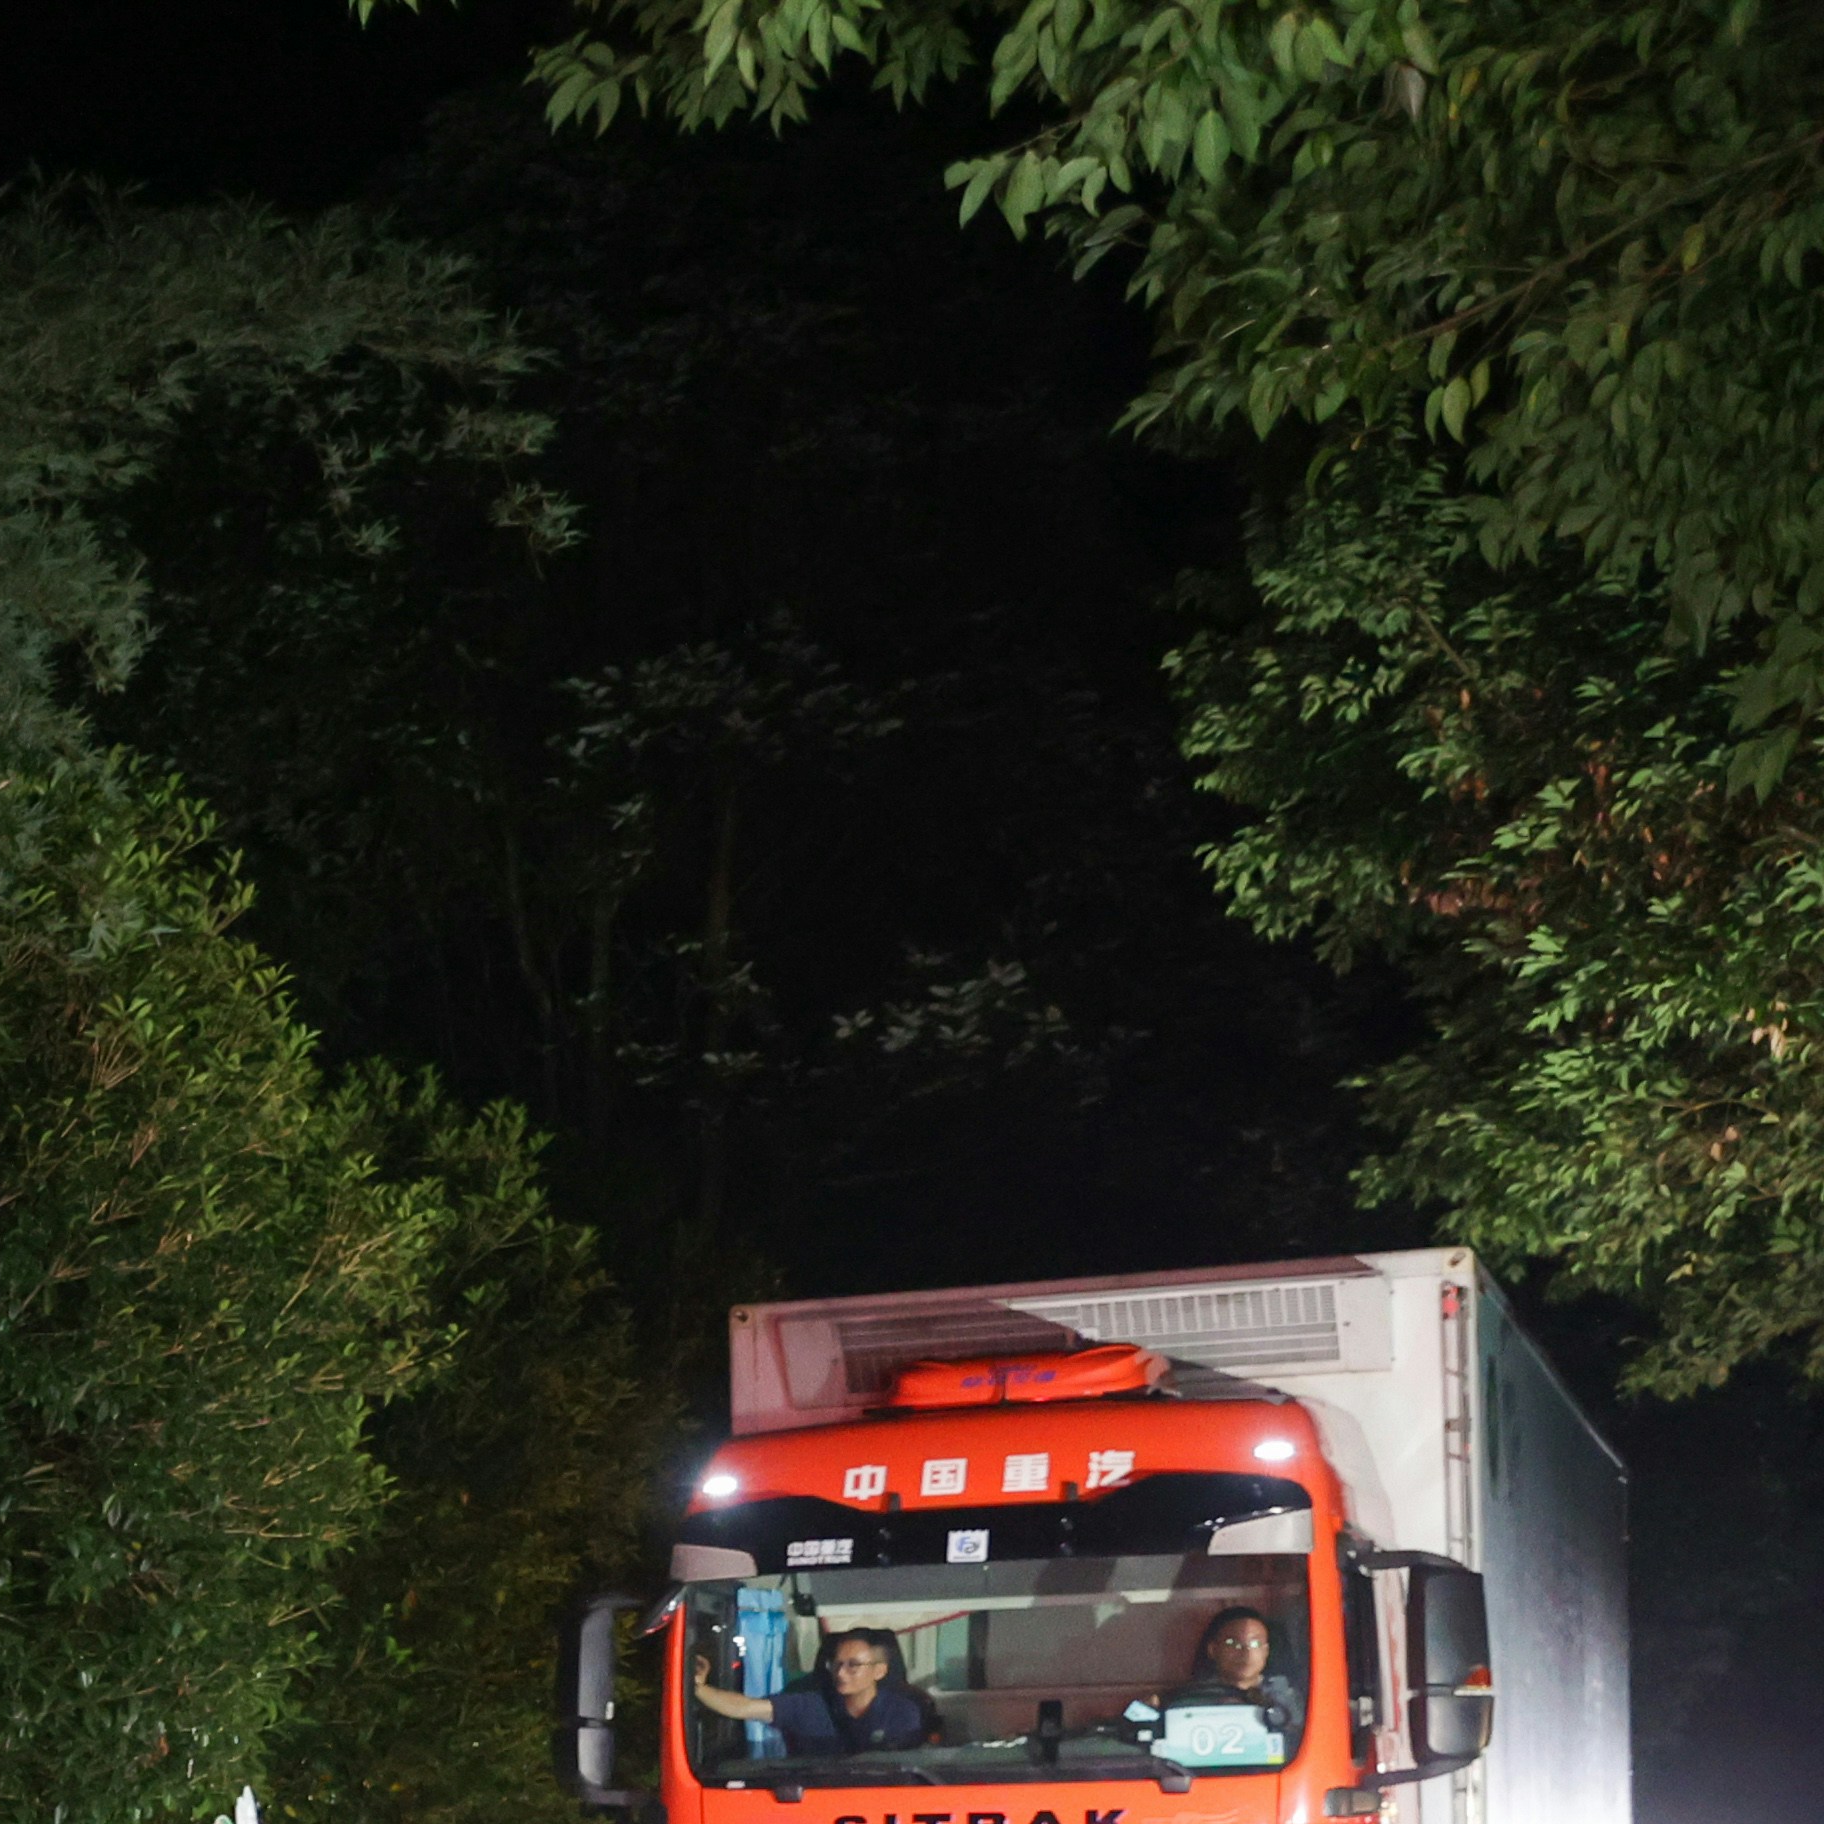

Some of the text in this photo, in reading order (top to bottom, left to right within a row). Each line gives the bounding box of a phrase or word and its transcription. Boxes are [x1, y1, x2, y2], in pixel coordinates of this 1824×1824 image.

[843, 1450, 1136, 1500] 中国重汽
[1191, 1725, 1245, 1756] 02
